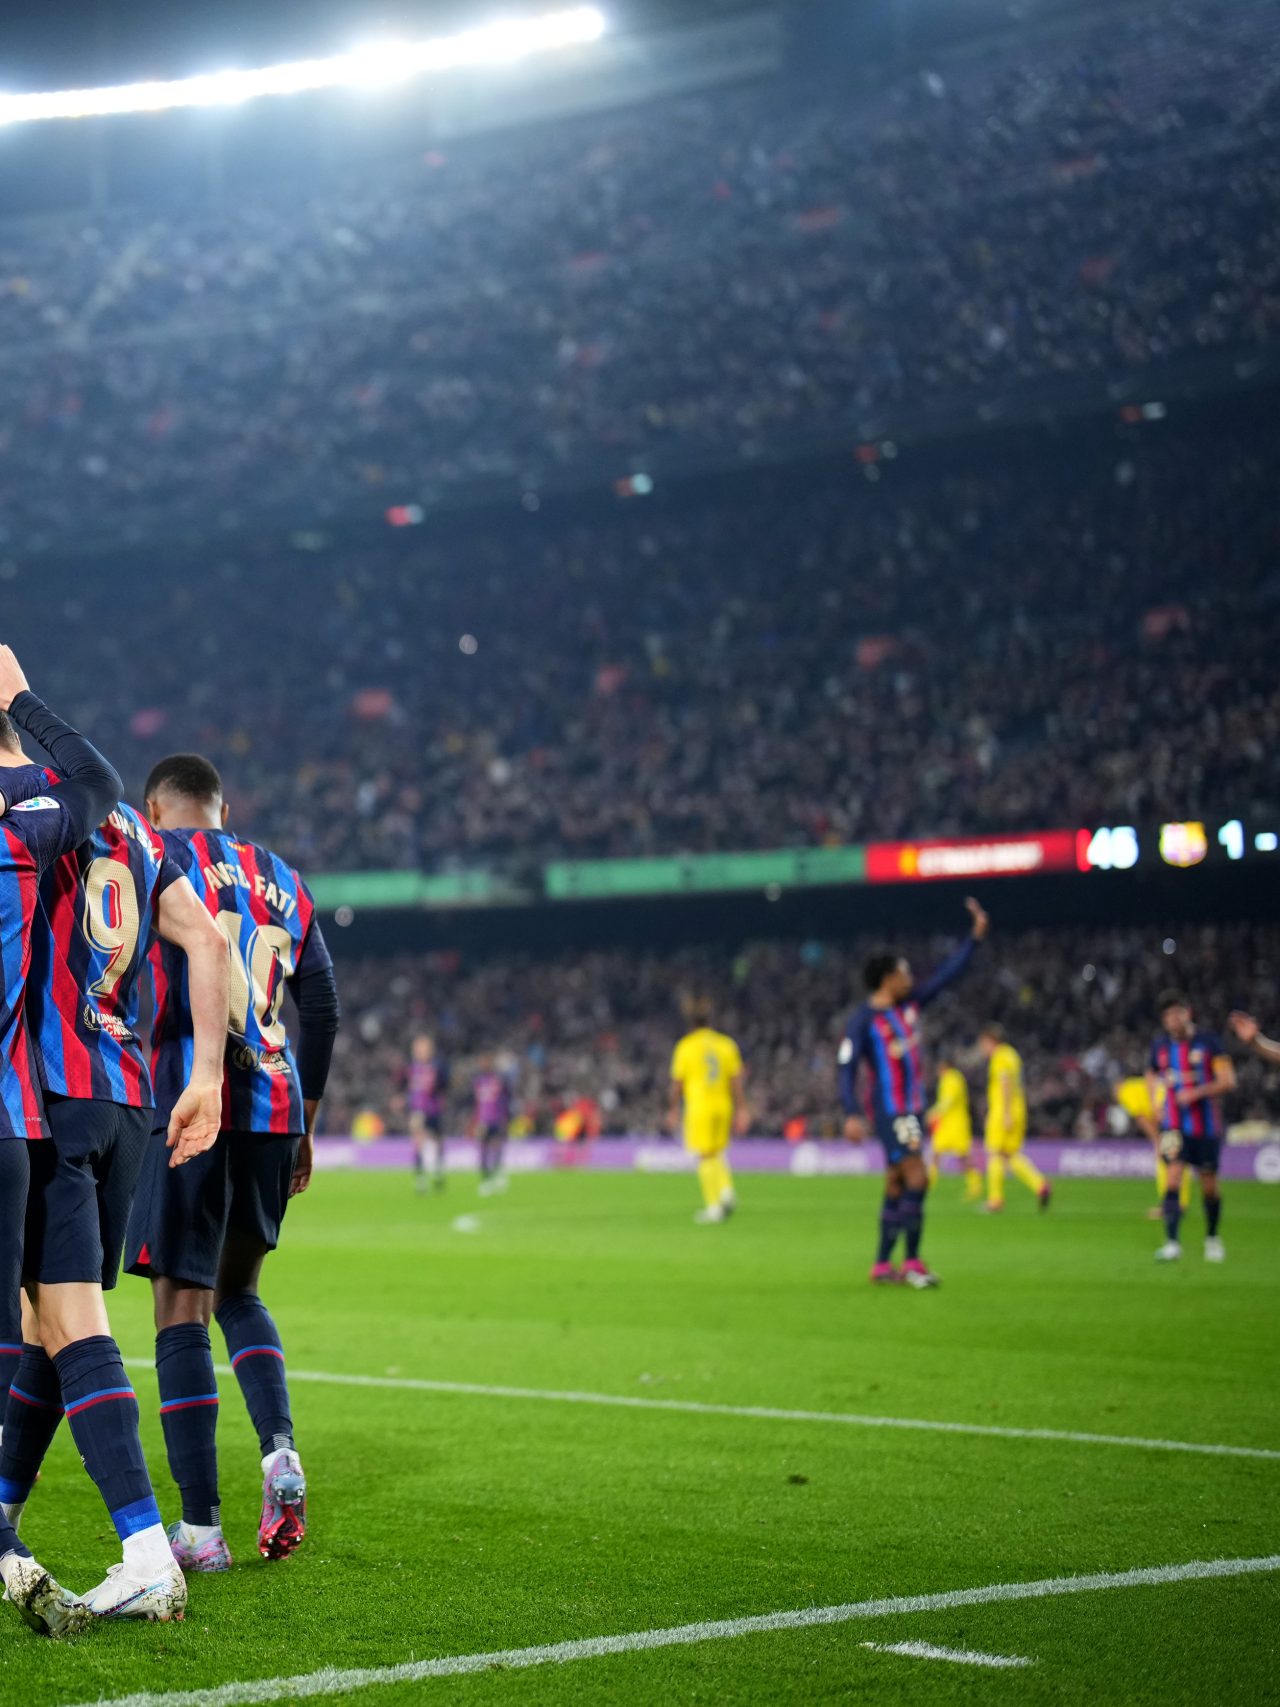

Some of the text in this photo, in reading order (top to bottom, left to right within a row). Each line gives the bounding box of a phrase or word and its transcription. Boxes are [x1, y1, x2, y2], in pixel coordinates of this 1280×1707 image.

[83, 857, 139, 999] 9
[254, 874, 296, 919] FATI
[214, 909, 295, 1046] 10
